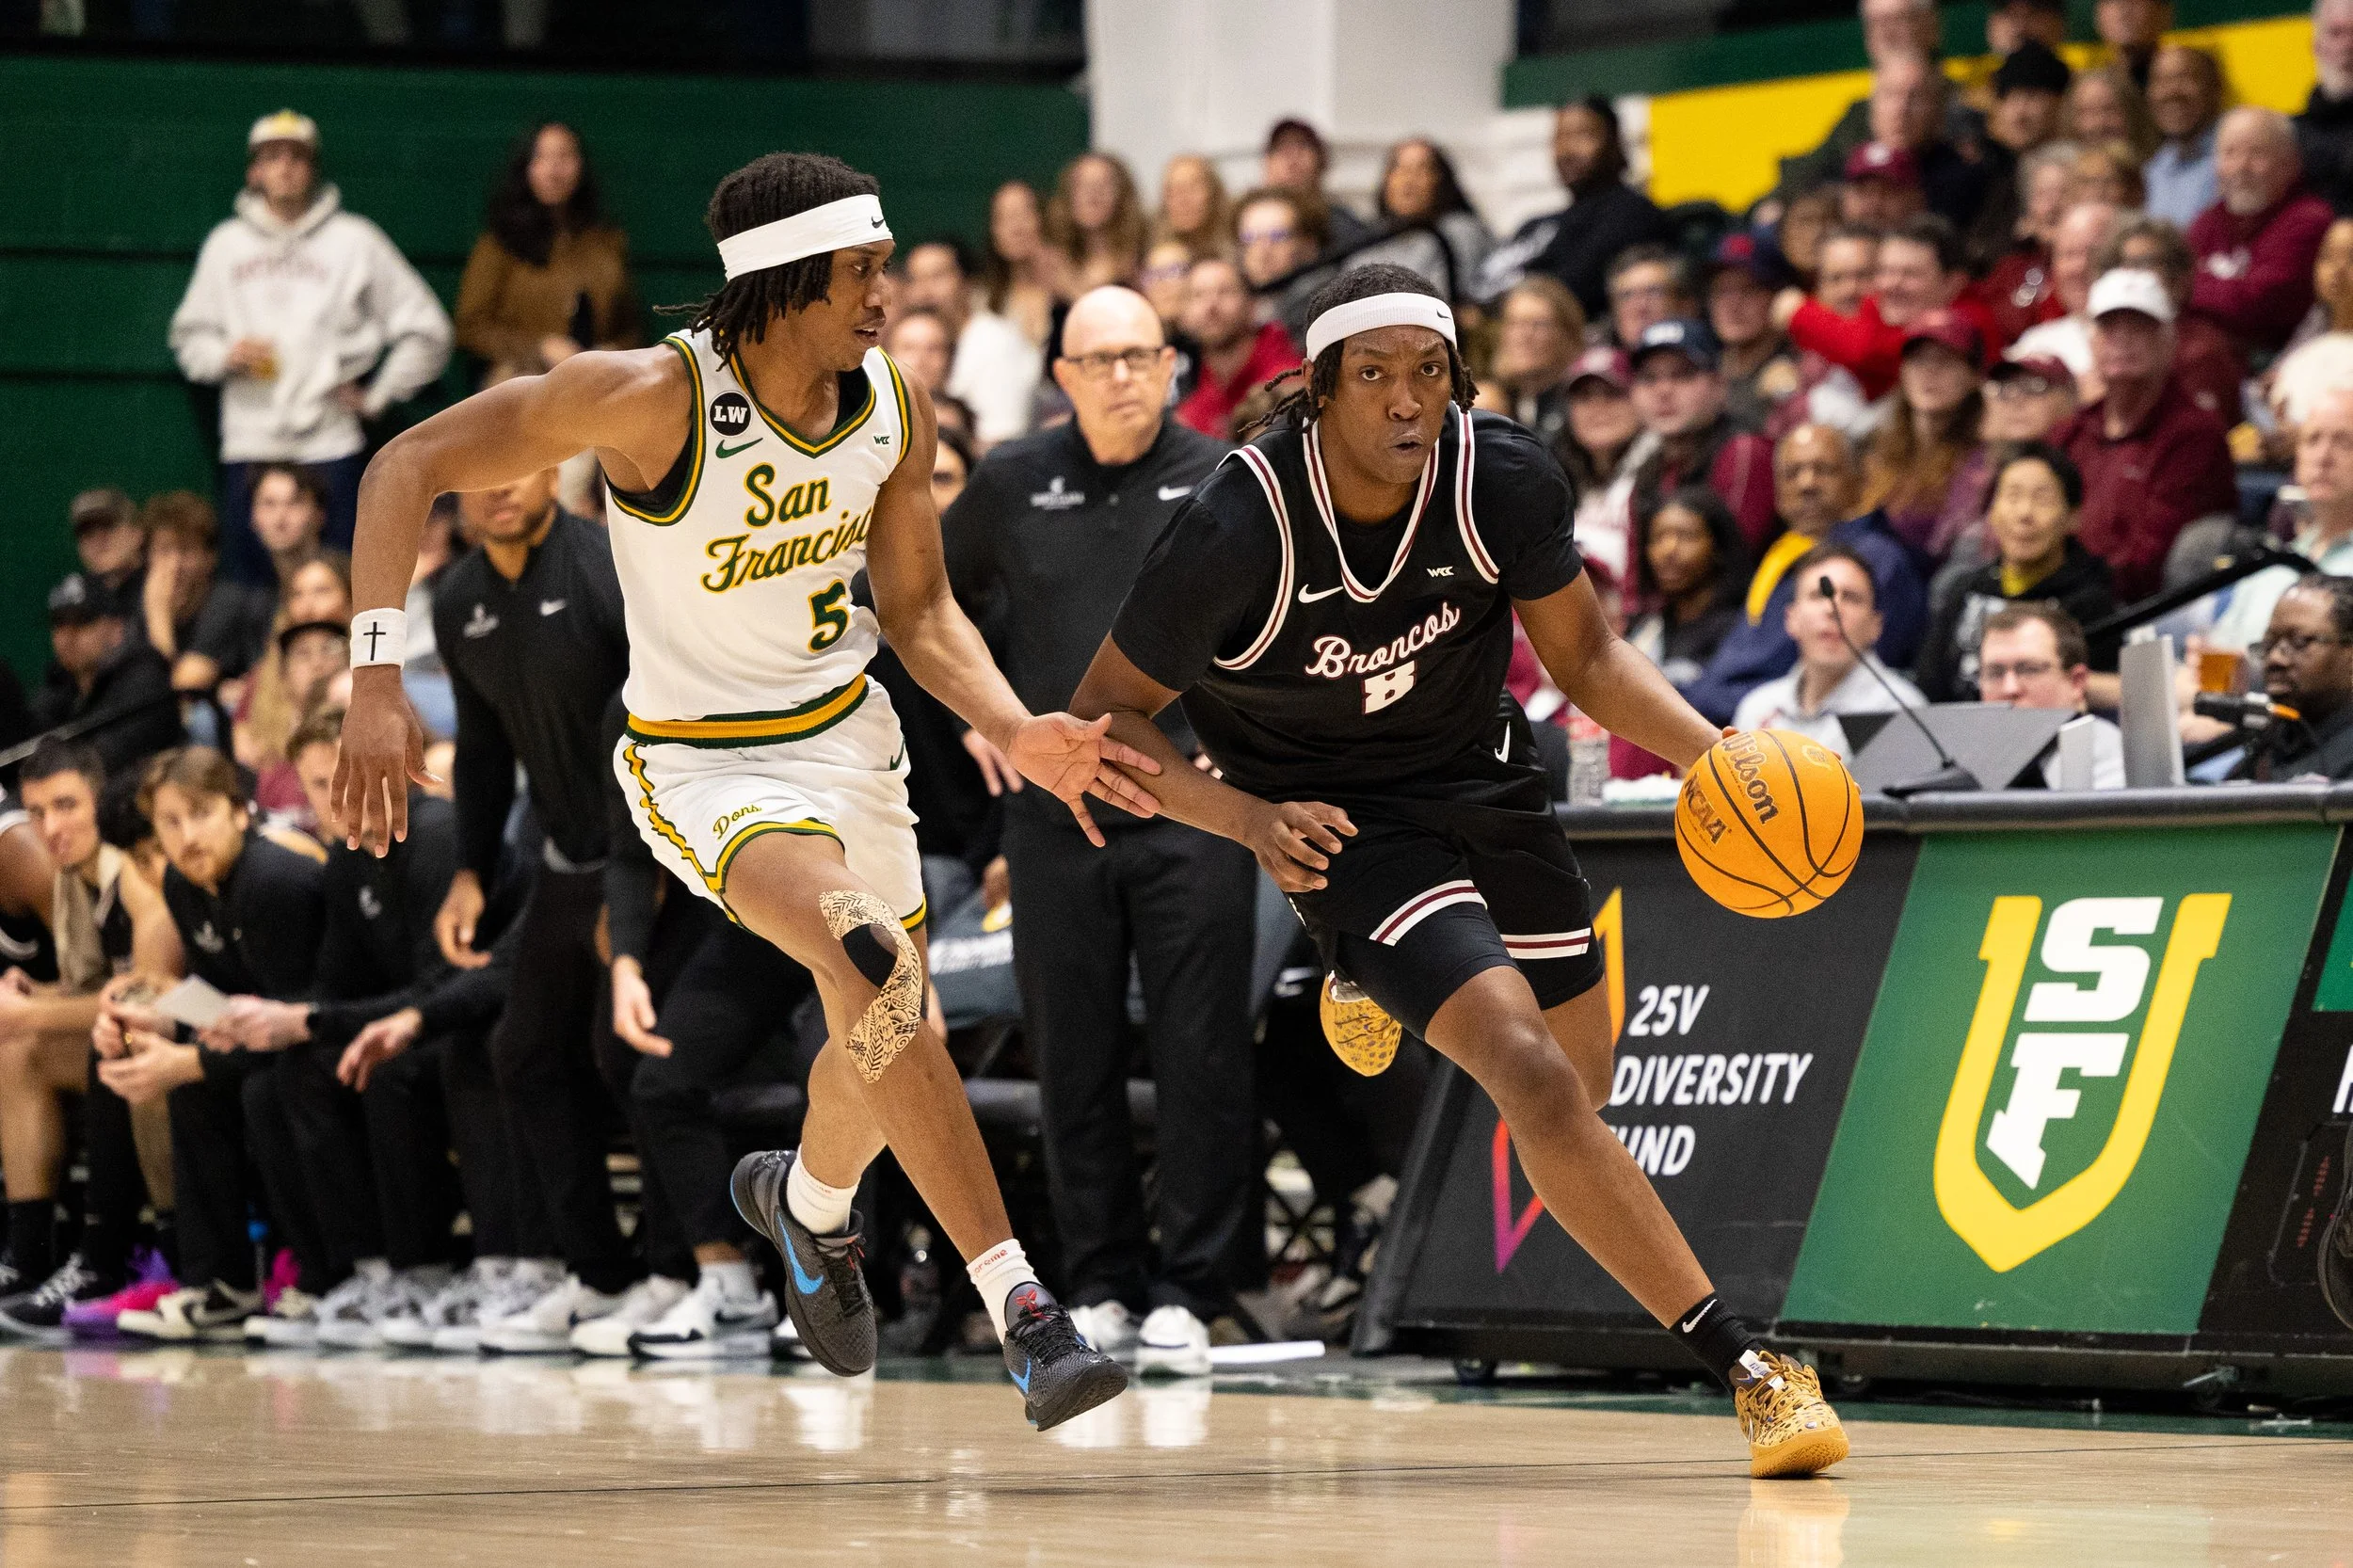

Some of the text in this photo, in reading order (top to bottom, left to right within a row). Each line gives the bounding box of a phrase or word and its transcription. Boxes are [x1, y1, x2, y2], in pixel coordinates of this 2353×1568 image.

[713, 405, 747, 424] LW
[744, 462, 832, 529] San
[700, 505, 872, 593] Francisc
[1427, 566, 1454, 578] WCC
[808, 578, 850, 653] 5
[1304, 600, 1461, 680] Broncos
[1362, 659, 1417, 715] 8
[1721, 731, 1780, 825] Wilson
[712, 804, 762, 840] Dons
[1684, 770, 1729, 845] NCAA
[1627, 984, 1711, 1037] 25V
[1608, 1051, 1815, 1108] DIVERSITY
[1609, 1124, 1697, 1176] UND
